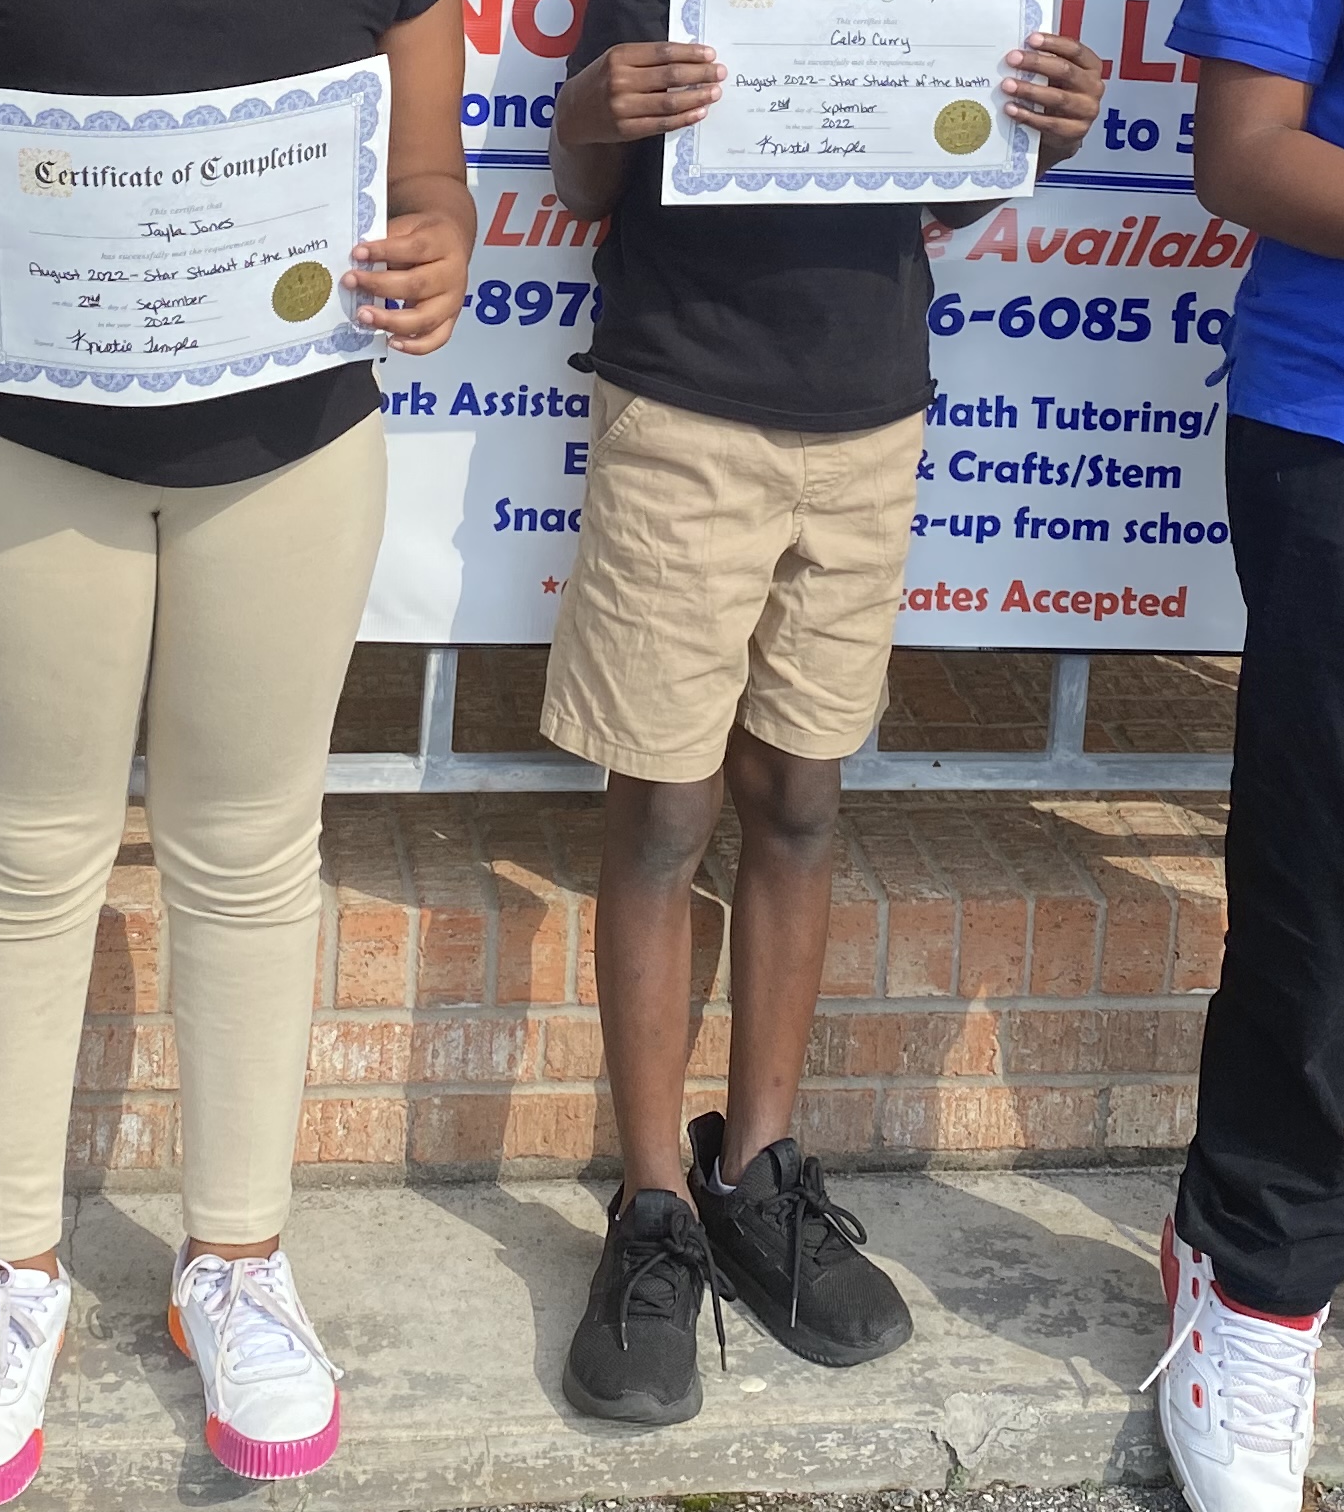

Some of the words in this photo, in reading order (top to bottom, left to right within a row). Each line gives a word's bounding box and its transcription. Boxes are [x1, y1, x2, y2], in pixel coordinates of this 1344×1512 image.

[872, 32, 911, 54] Curry
[736, 74, 777, 92] August
[930, 76, 951, 87] the
[821, 118, 855, 129] 2022
[1104, 107, 1160, 151] to
[35, 161, 163, 189] Certificate
[172, 161, 195, 185] of
[200, 142, 328, 186] Completion
[189, 218, 234, 236] Jones
[29, 261, 80, 283] August
[260, 251, 282, 265] the
[144, 315, 185, 328] 2022
[1013, 506, 1110, 542] from
[899, 581, 989, 613] ates
[1000, 580, 1188, 621] Accepted
